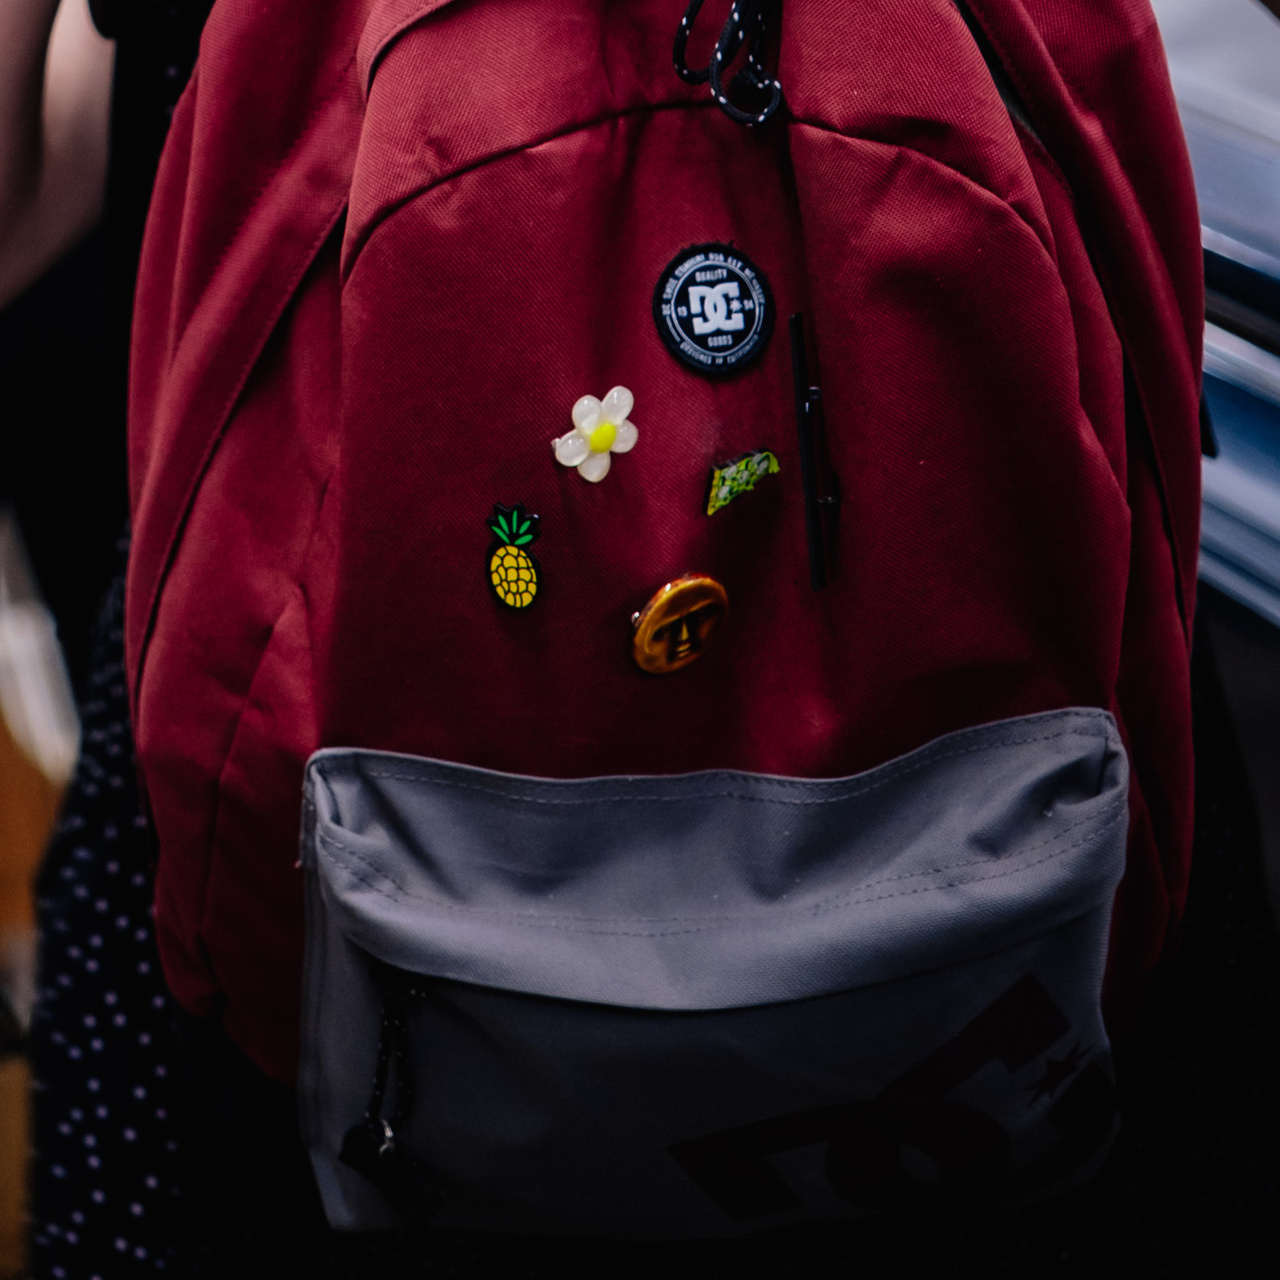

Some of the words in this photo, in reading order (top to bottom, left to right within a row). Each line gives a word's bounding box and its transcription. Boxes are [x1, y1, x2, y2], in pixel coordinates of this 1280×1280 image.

[695, 268, 728, 282] QUALITY
[688, 282, 745, 336] DC
[707, 335, 733, 347] GOODS
